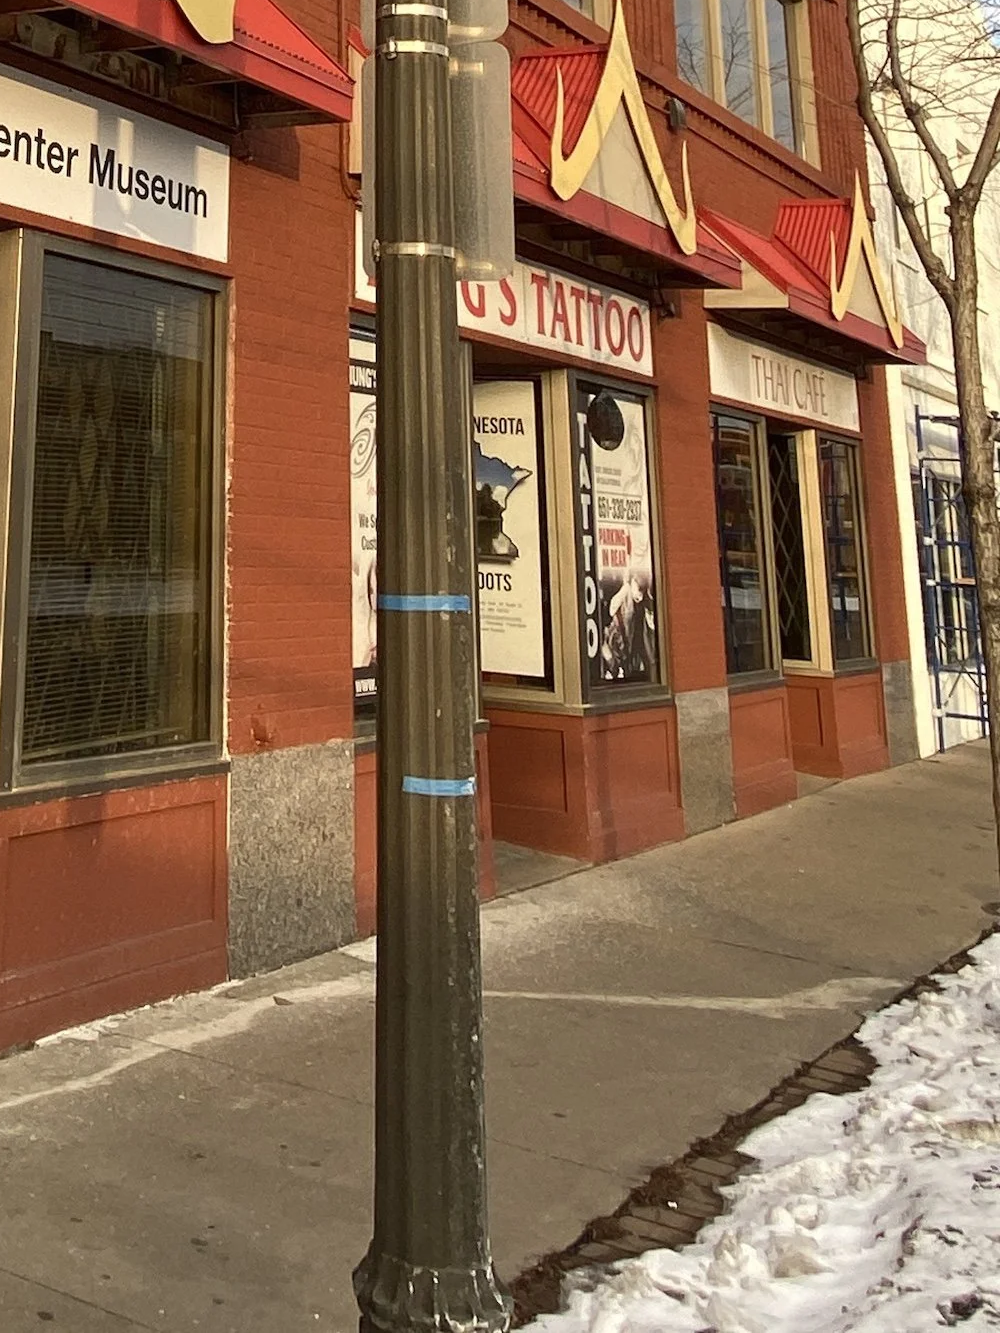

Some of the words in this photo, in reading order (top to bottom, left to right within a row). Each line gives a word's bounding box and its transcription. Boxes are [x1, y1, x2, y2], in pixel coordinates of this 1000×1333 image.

[88, 142, 208, 219] Museum
[531, 272, 644, 362] TATTOO
[751, 354, 790, 406] THAI
[792, 370, 829, 417] CAFÉ
[576, 412, 599, 659] TATTOO
